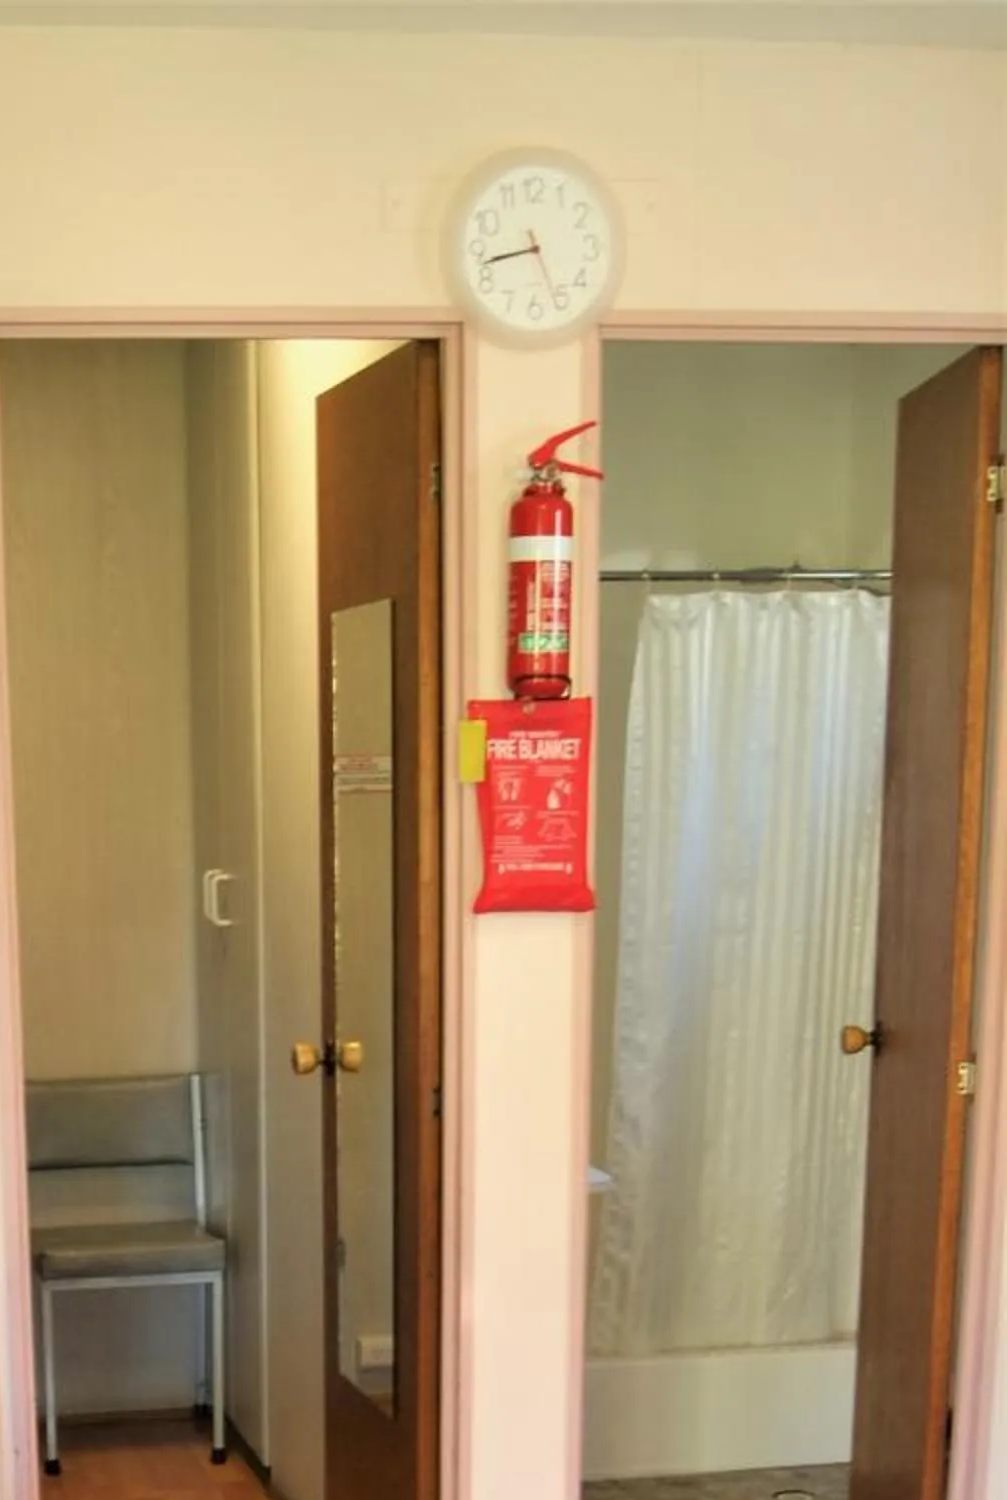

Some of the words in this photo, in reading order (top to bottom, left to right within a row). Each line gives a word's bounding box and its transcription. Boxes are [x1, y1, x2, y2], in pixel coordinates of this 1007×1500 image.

[500, 184, 516, 209] 11
[523, 176, 546, 204] 12
[557, 185, 566, 208] 1
[475, 208, 500, 236] 10
[572, 202, 590, 229] 2
[469, 239, 486, 265] 9
[583, 234, 600, 261] 3
[478, 265, 494, 294] 8
[572, 268, 587, 288] 4
[501, 290, 516, 314] 7
[527, 294, 544, 321] 6
[554, 284, 570, 311] 5
[486, 739, 517, 760] FIRE
[519, 738, 581, 760] BLANKET
